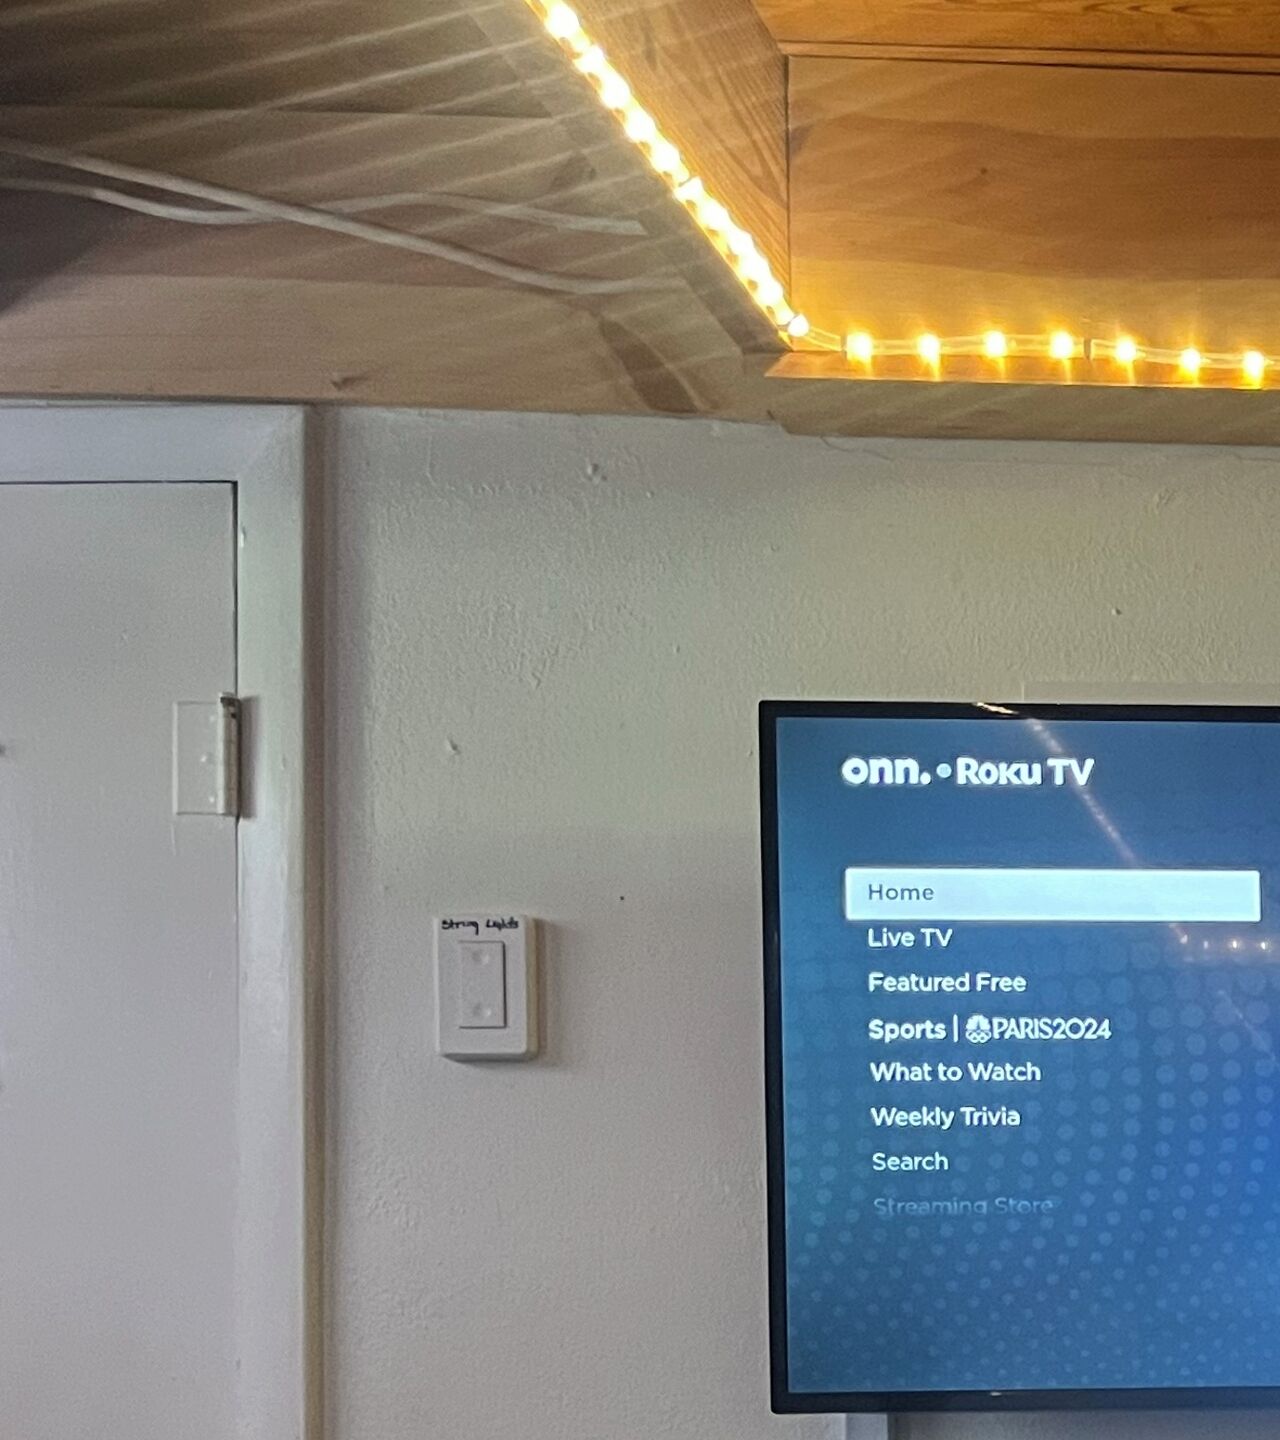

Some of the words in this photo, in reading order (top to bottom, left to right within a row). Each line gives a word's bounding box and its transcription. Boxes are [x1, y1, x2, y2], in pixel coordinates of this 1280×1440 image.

[841, 756, 931, 785] onn.
[1048, 758, 1094, 785] TV
[868, 884, 934, 902] Home
[441, 918, 479, 935] String
[868, 929, 914, 948] Live
[921, 929, 953, 948] TV
[868, 973, 970, 992] Featured
[976, 974, 1027, 992] Free
[868, 1020, 947, 1042] Sports
[993, 1018, 1112, 1040] PARIS2024
[870, 1062, 932, 1081] What
[938, 1064, 963, 1081] to
[967, 1062, 1041, 1081] Watch
[871, 1107, 954, 1129] Weekly
[960, 1107, 1021, 1126] Trivia
[872, 1152, 949, 1171] Search
[994, 1197, 1053, 1214] Store
